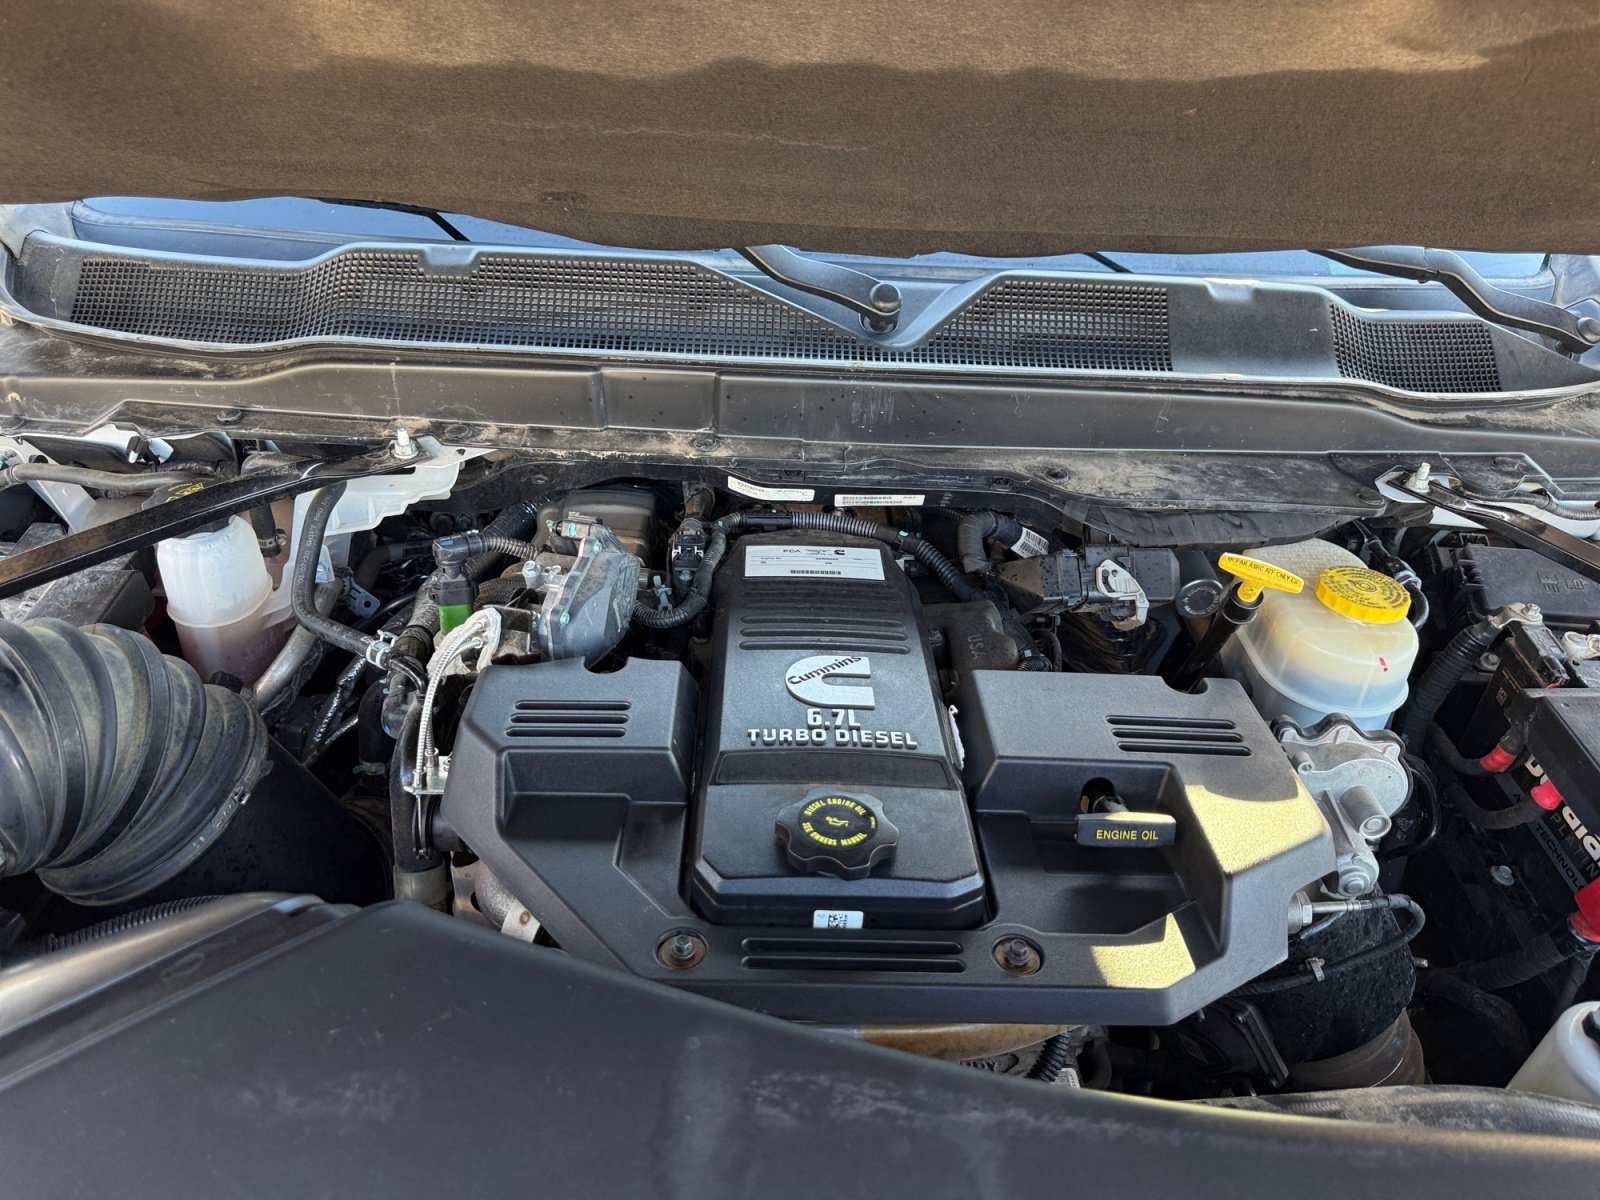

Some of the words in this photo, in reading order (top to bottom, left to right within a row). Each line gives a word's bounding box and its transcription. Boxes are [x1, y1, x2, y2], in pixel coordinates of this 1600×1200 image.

[787, 655, 863, 686] Cummins
[806, 708, 862, 731] 6.7L
[747, 728, 828, 747] TURBO
[834, 729, 919, 750] DIESEL
[803, 800, 827, 816] DIESEL
[826, 798, 857, 809] ENGINE
[854, 805, 867, 816] OIL
[802, 821, 814, 833] SEE
[840, 831, 868, 847] MANUAL
[1095, 829, 1138, 841] ENGINE
[1141, 830, 1159, 841] OIL
[1549, 813, 1600, 878] PLATIN
